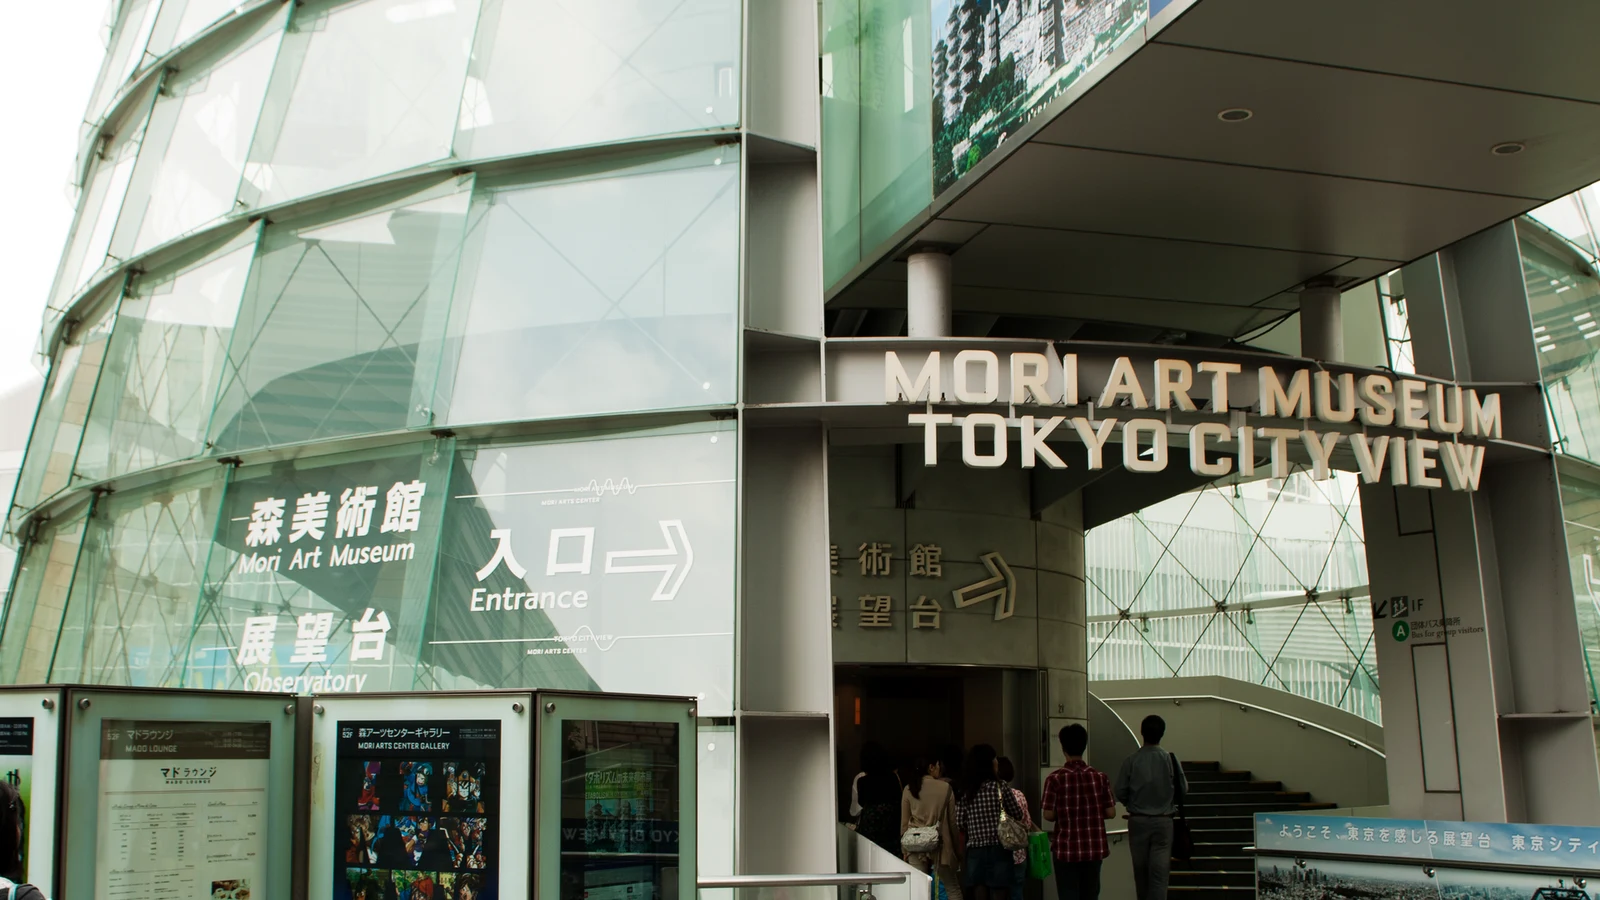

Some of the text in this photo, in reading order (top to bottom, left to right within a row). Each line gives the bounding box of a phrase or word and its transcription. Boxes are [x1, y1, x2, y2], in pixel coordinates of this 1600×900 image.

[885, 350, 1503, 440] MORI ART MUSEUM
[908, 413, 1486, 492] TOKYO CITY VIEW
[245, 479, 427, 547] 森美術館
[238, 542, 416, 574] Mori Art Museum
[475, 527, 596, 582] 入口
[470, 587, 588, 612] Entrance
[236, 607, 392, 667] 展望台
[1396, 625, 1406, 637] A
[1411, 630, 1423, 639] Bus
[1424, 629, 1435, 638] for
[1459, 626, 1484, 635] visitors
[244, 667, 367, 693] Observatory
[126, 729, 174, 741] マドラウンジ
[358, 727, 451, 738] 森アーツセンターギャラリー
[149, 745, 178, 753] LOUNGE
[358, 742, 450, 750] MORI ARTS CENTER GALLERY
[1279, 823, 1491, 849] ようこそ、東京を感じる展望台
